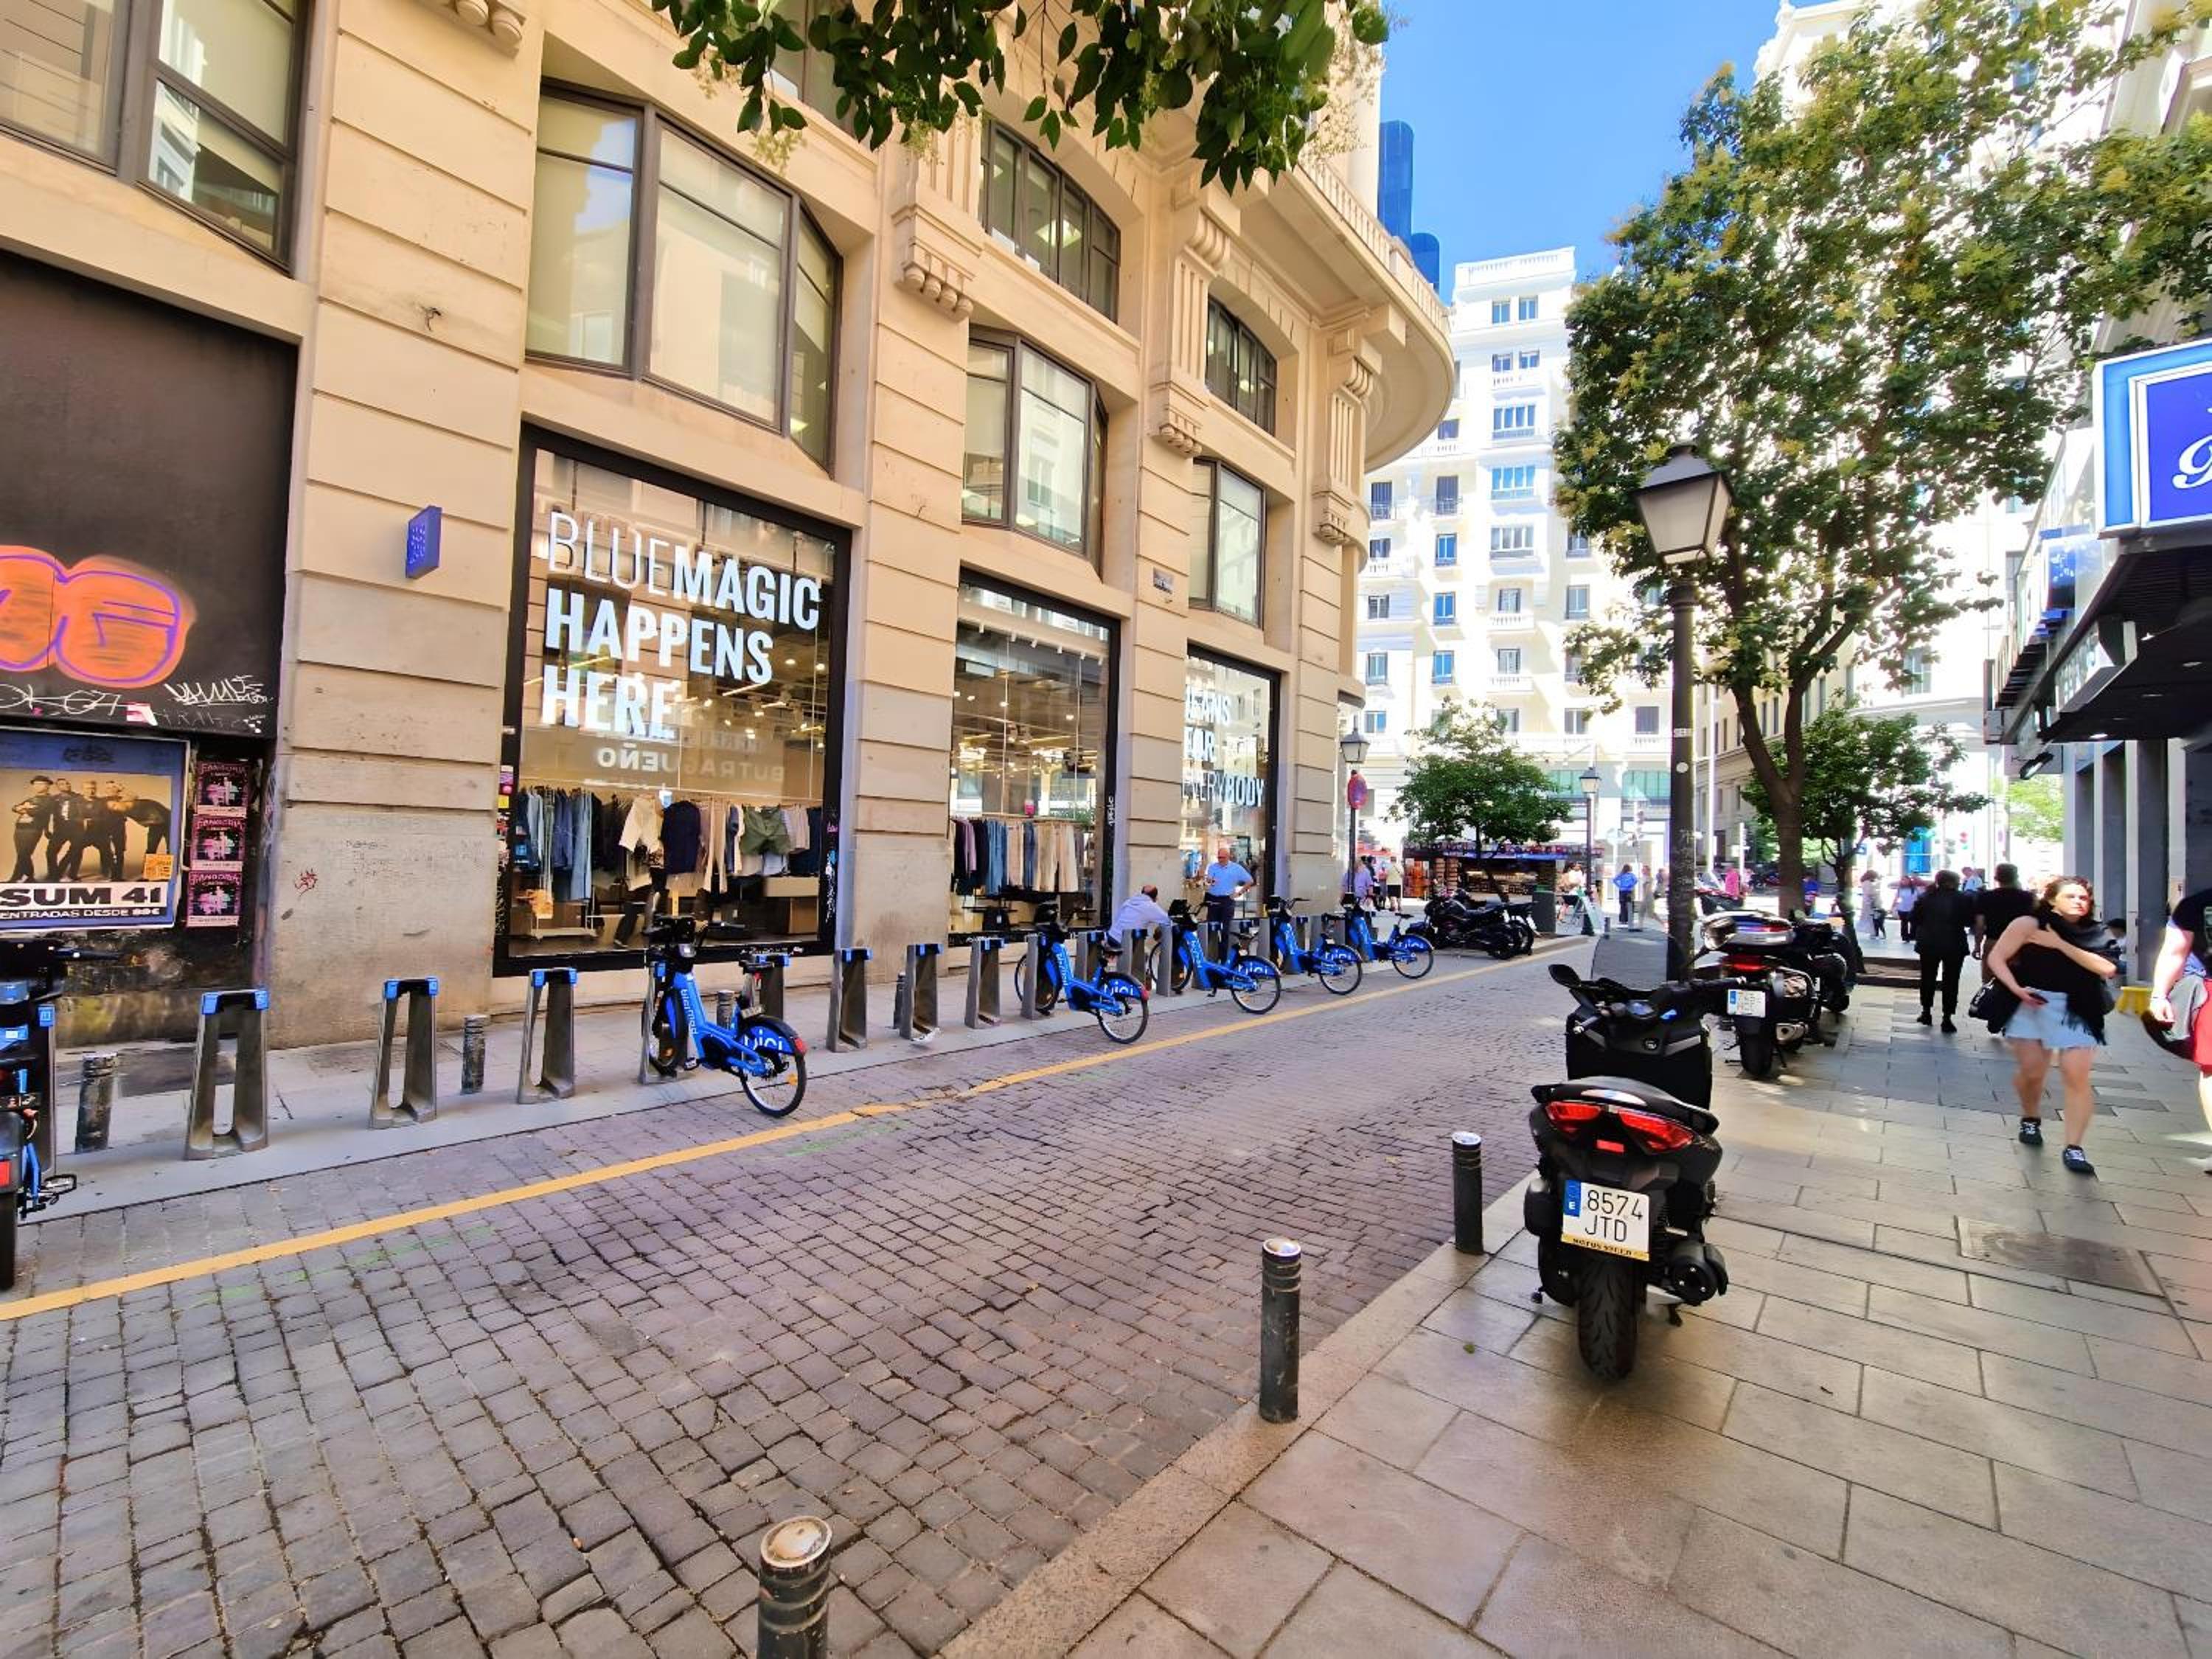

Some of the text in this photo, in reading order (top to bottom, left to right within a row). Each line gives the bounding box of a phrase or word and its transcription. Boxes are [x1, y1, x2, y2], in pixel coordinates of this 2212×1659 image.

[549, 511, 821, 631] BLUEMAGIC
[545, 588, 773, 685] HAPPENS
[542, 664, 677, 740] HERE
[1185, 684, 1231, 727] JEANS
[1183, 726, 1216, 762] FOR
[0, 887, 161, 908] SUM 41
[0, 910, 80, 919] ENTRADAS
[83, 908, 129, 917] DESDE
[1568, 1201, 1576, 1210] E
[1587, 1189, 1643, 1220] 8574
[1585, 1215, 1627, 1242] JTD
